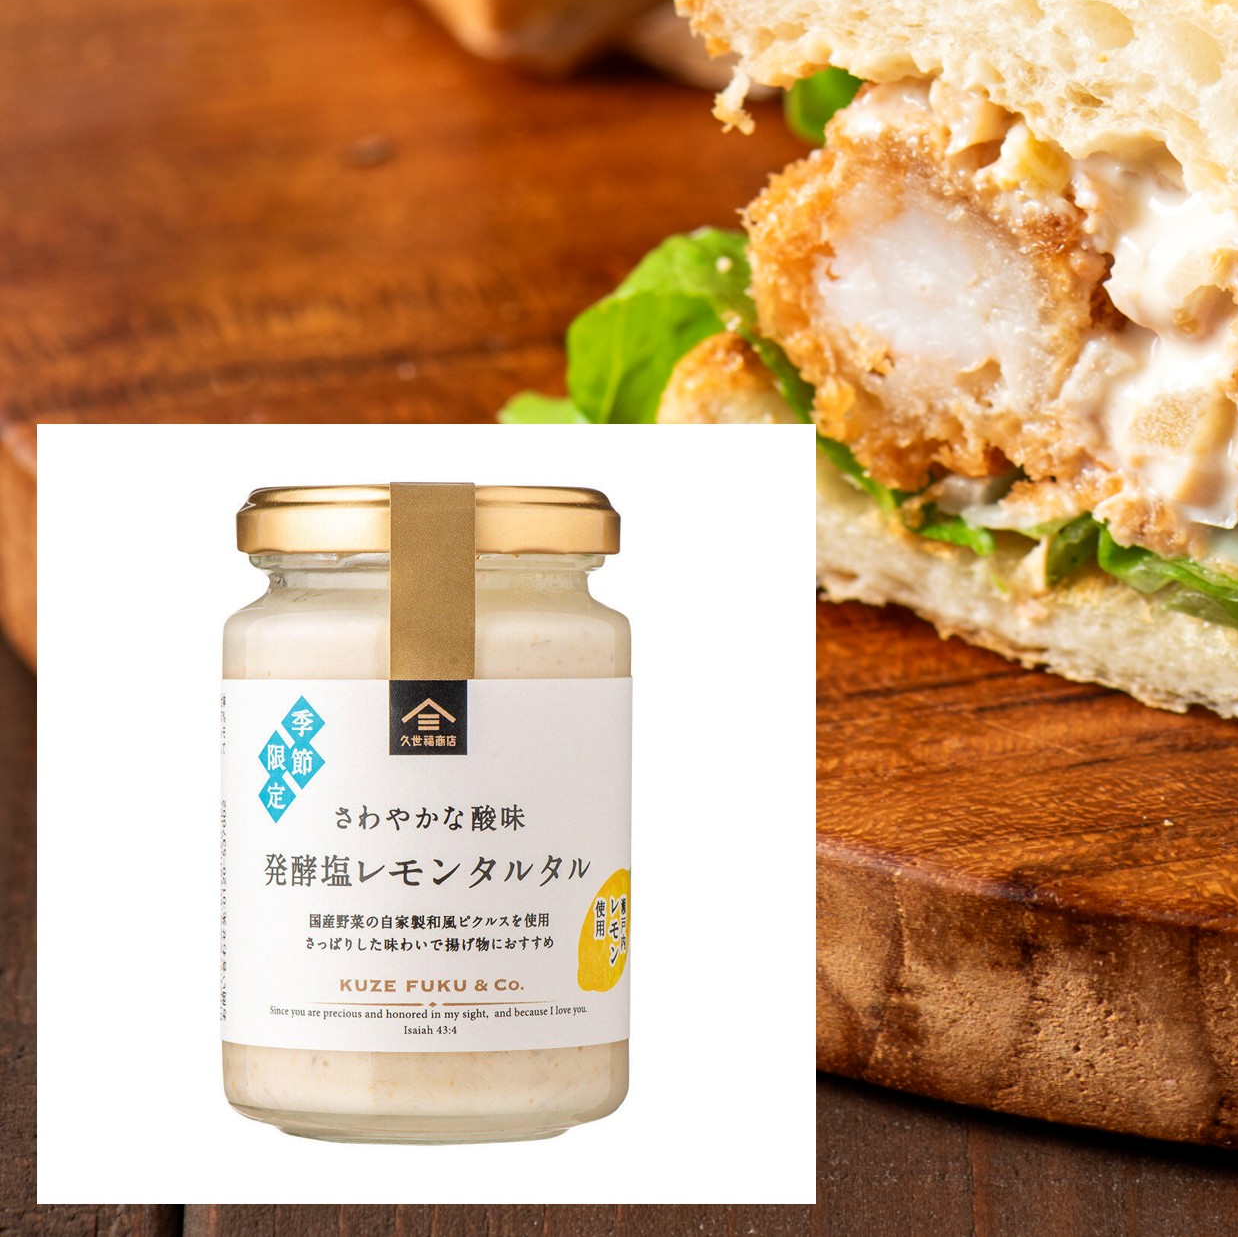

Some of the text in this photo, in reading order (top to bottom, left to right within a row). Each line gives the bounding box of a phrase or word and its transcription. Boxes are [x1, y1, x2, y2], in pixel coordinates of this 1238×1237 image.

[290, 709, 314, 776] 季節
[400, 734, 457, 748] 久世福商店
[267, 744, 287, 810] 限定
[334, 804, 526, 832] さわやかな酸味
[264, 853, 591, 889] 発酵塩レモンタルタル
[309, 913, 550, 929] 国産野菜の自家製和風ピクルスを使用
[595, 900, 606, 937] 使用
[609, 899, 619, 964] レモン
[305, 936, 554, 952] さっぱりした味わいで揚げ物におすすめ
[339, 978, 525, 993] KUZE FUKU & Co.
[269, 1005, 588, 1021] Since you are precious and honored in my sight, and because I love you.
[404, 1025, 457, 1035] Isaiah 43:4
